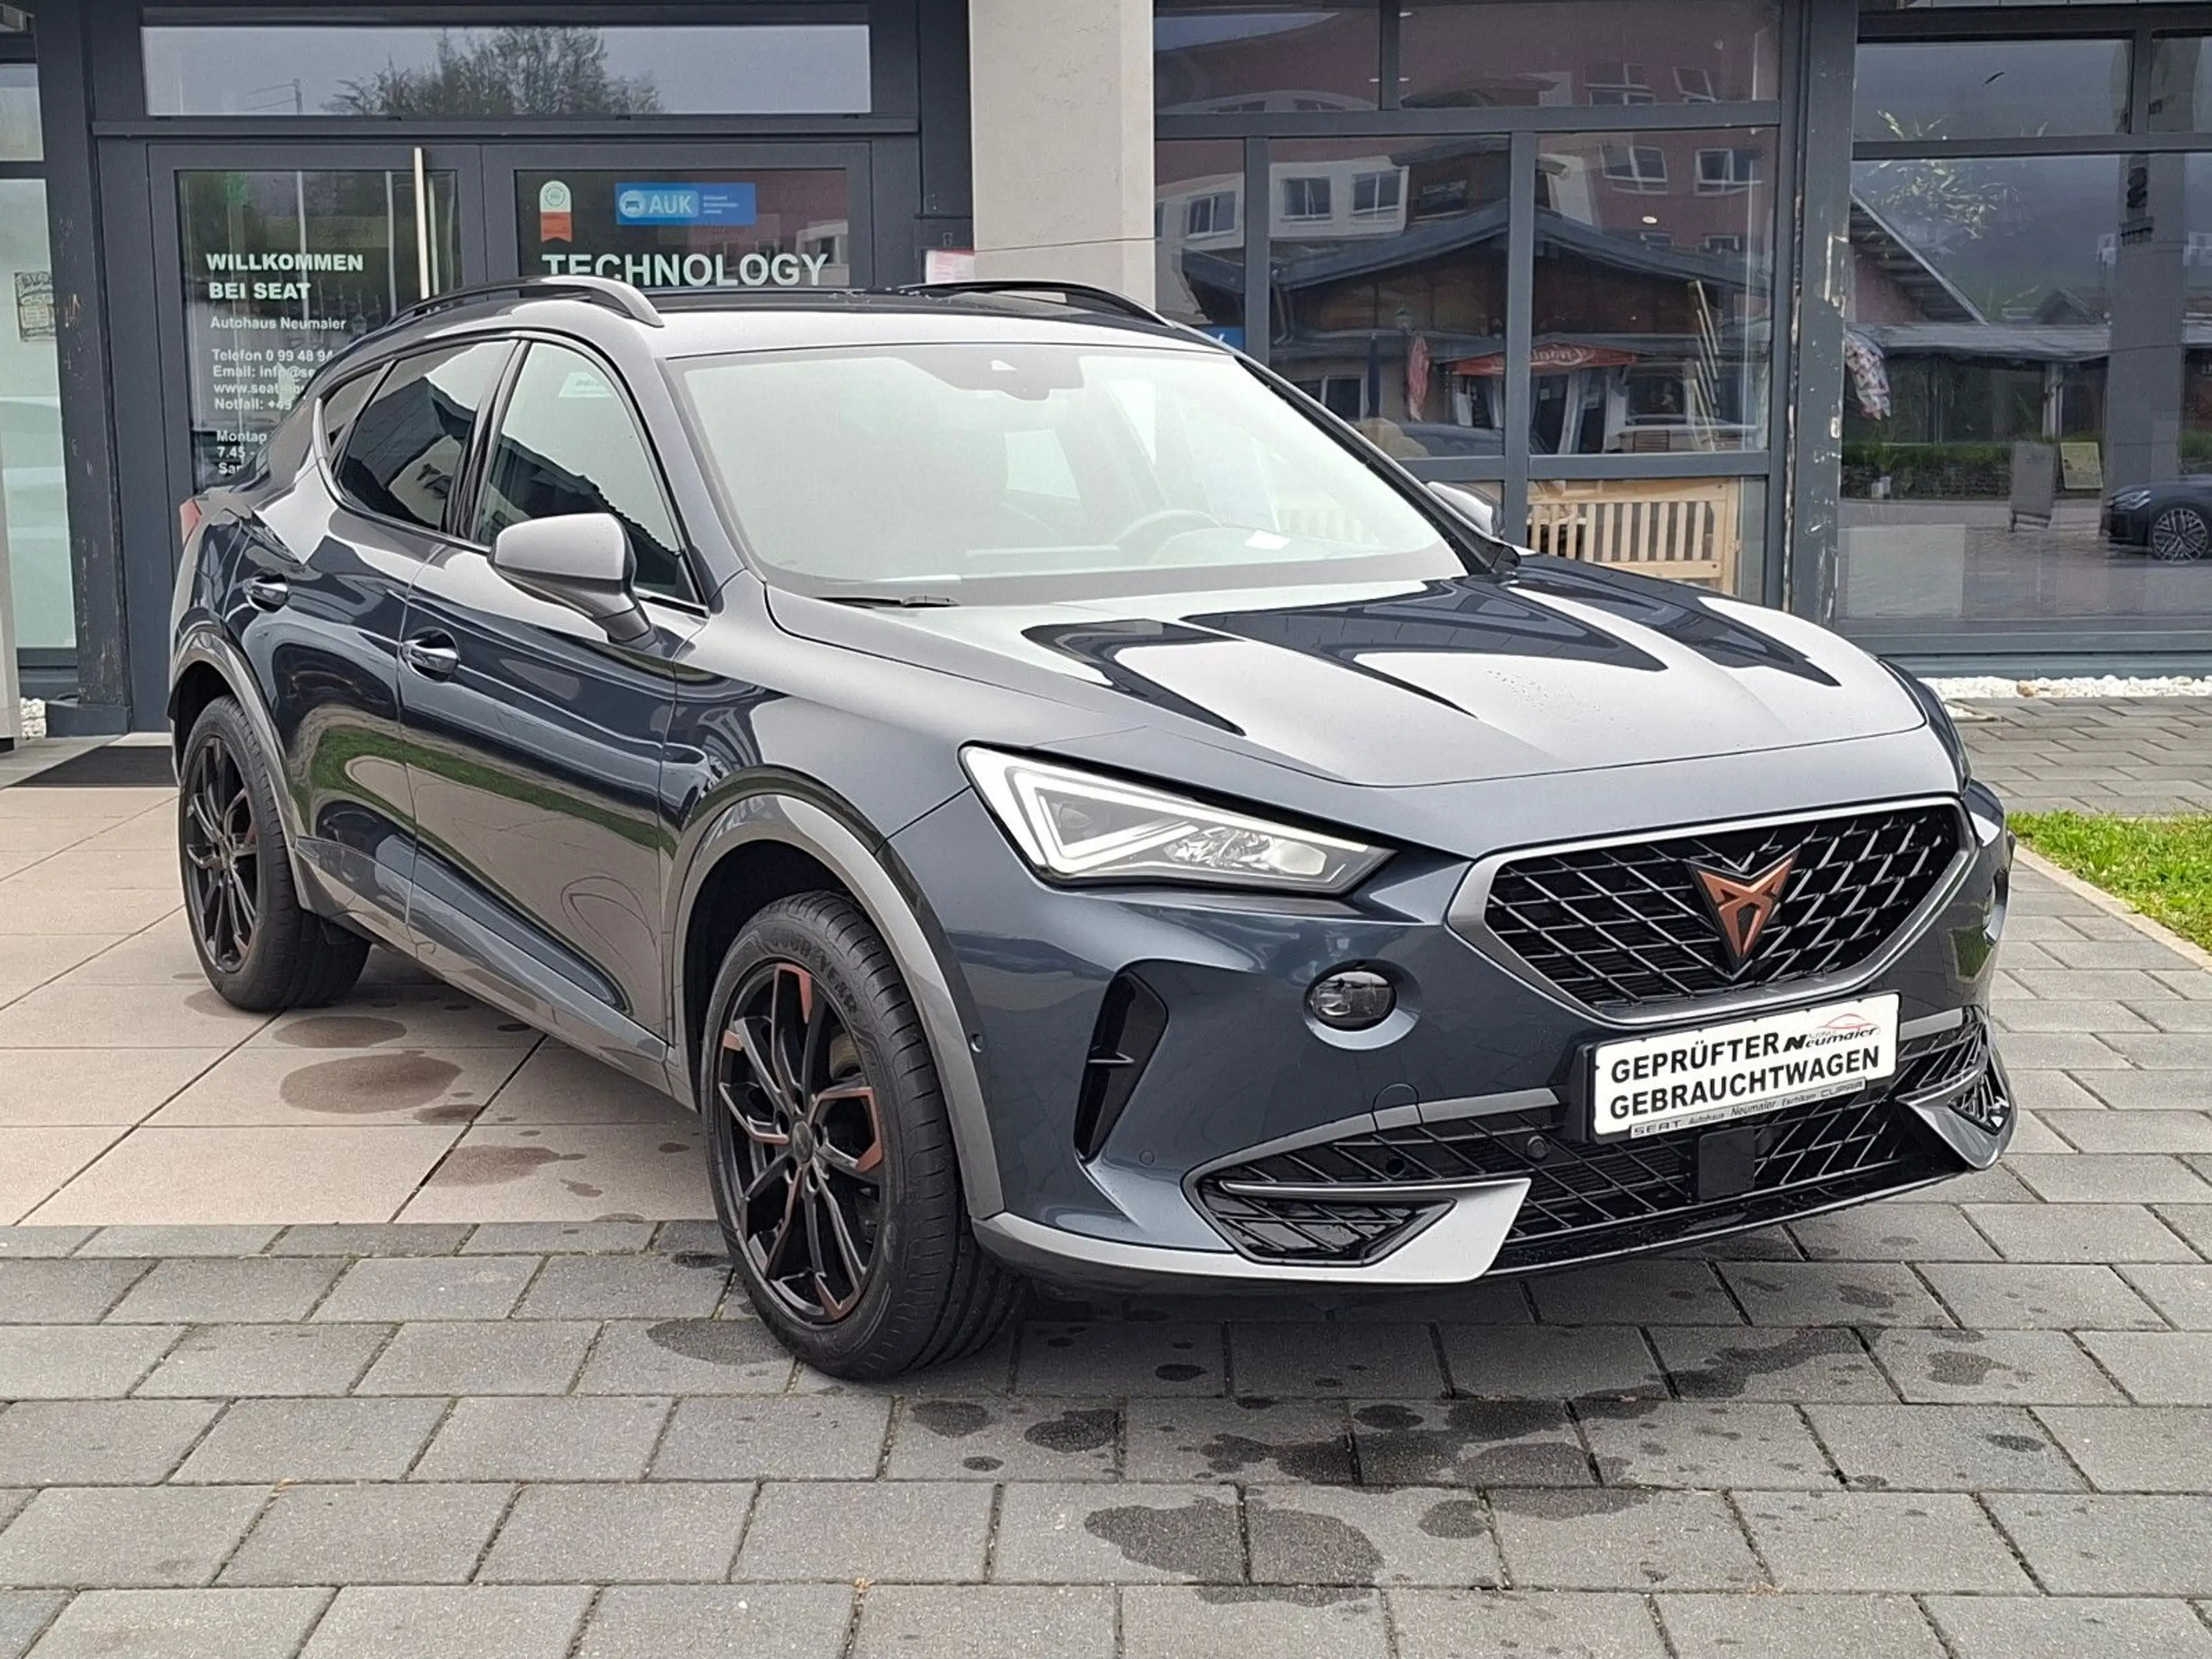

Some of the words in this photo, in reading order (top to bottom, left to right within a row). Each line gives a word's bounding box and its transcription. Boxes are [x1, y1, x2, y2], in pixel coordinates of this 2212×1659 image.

[649, 195, 693, 214] AUK
[206, 254, 363, 270] WILLKOMMEN
[542, 254, 828, 286] TECHNOLOGY
[209, 283, 246, 298] BEI
[254, 283, 311, 299] SEAT
[211, 317, 276, 329] Autohaus
[281, 317, 346, 329] Neumaier
[211, 349, 262, 361] Telefon
[266, 349, 274, 361] 0
[277, 349, 294, 362] 99
[297, 350, 313, 362] 48
[213, 365, 255, 377] Email:
[215, 398, 263, 410] Notfall:
[217, 446, 245, 458] 7.45
[1783, 1027, 1879, 1052] Neumaier
[1611, 1032, 1779, 1083] GEPRÜFTER
[1610, 1046, 1880, 1119] GEBRAUCHTWAGEN
[1634, 1120, 1681, 1135] SEAT
[1730, 1100, 1777, 1116] Neumaier
[1820, 1081, 1863, 1097] CUPRA
